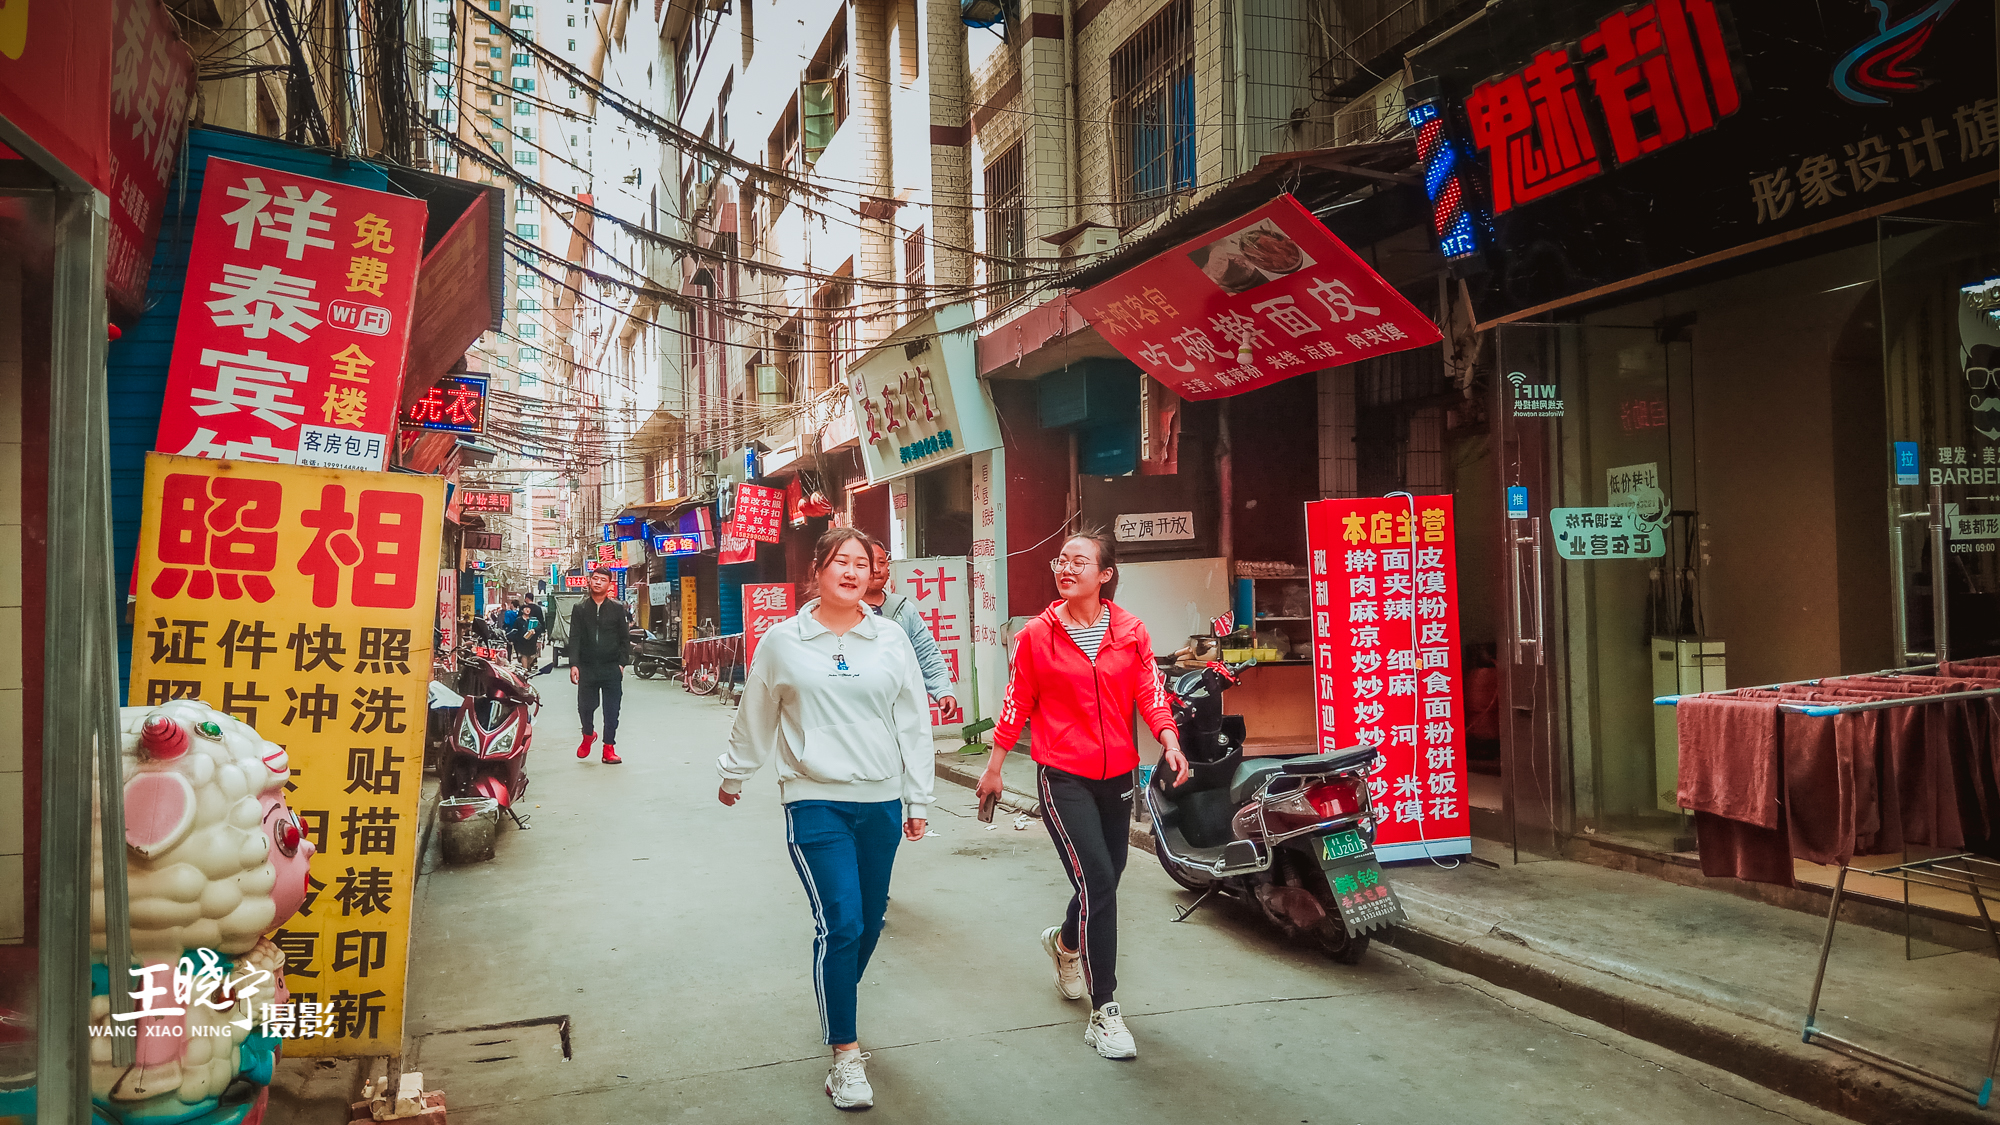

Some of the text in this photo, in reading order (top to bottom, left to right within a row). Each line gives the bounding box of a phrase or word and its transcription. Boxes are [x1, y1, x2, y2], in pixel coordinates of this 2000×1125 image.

[111, 0, 188, 188] 泰宾馆
[1465, 0, 1741, 213] 魅都
[1749, 97, 2000, 225] 形象设计旗
[345, 213, 395, 298] 免费
[1138, 277, 1381, 373] 吃碗擀面皮
[1265, 354, 1305, 371] 米线
[1301, 340, 1343, 361] 凉皮
[1345, 322, 1408, 350] 肉夹馍
[321, 343, 375, 429] 全楼
[410, 384, 479, 424] 洗衣
[304, 430, 381, 458] 客房包月
[1938, 447, 2000, 464] 理发·美
[1901, 450, 1914, 467] 拉
[464, 492, 510, 512] 化妆美甲
[738, 505, 780, 518] 订牛仔扣
[740, 496, 782, 509] 修改衣服
[1512, 493, 1524, 506] 推
[151, 472, 424, 609] 照相
[736, 523, 778, 537] 干洗水洗
[1120, 516, 1190, 539] 空调开放
[1342, 508, 1446, 546] 本店主营
[1959, 518, 2000, 535] 魅都形
[1345, 546, 1446, 573] 擀面皮
[1950, 542, 1995, 553] OPEN 09:00
[1350, 571, 1447, 598] 肉夹馍
[1348, 595, 1448, 623] 麻辣粉
[147, 616, 412, 675] 证件快照
[1350, 620, 1450, 649] 凉皮
[1351, 646, 1450, 674] 炒细面
[1352, 671, 1452, 699] 炒麻食
[1353, 697, 1453, 724] 炒面
[1354, 721, 1455, 748] 炒河粉
[268, 928, 387, 979] 复印
